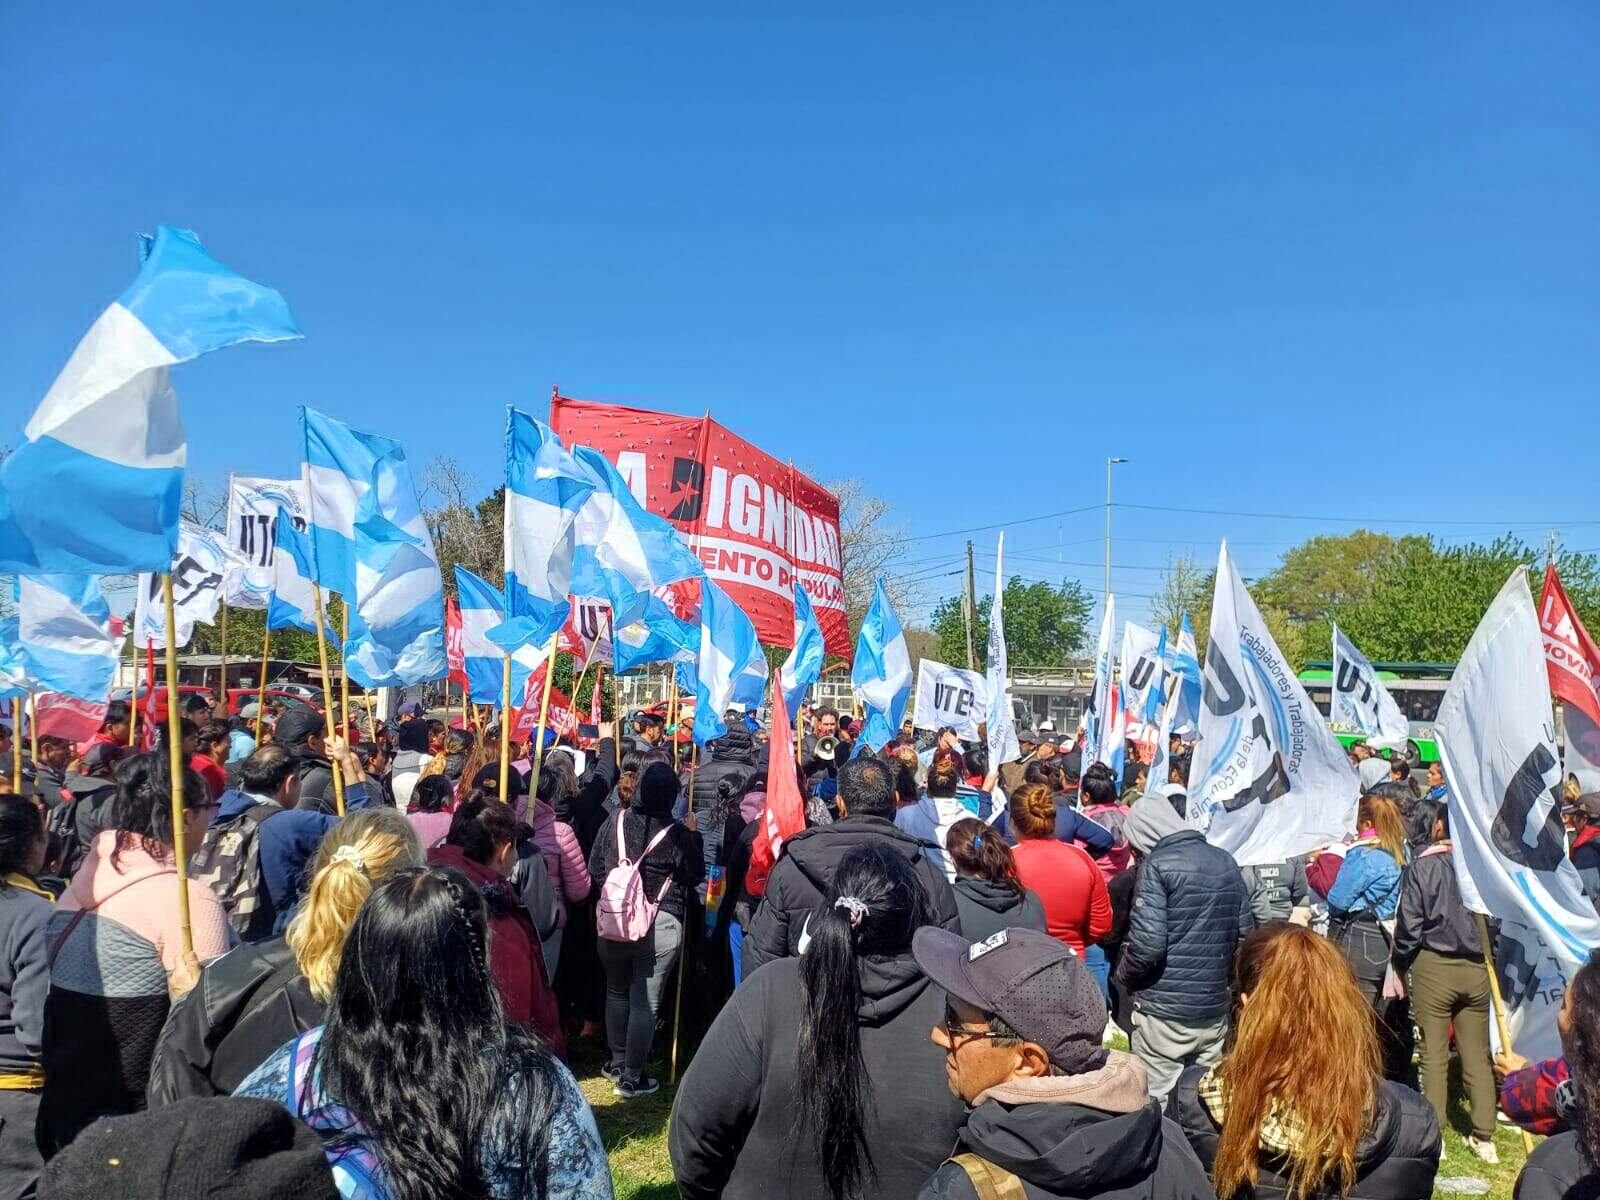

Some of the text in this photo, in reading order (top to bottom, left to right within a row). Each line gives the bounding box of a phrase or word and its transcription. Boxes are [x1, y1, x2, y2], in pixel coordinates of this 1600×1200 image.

[614, 451, 841, 573] A DIGNIDAD
[1240, 625, 1309, 774] Trabajadores y Trabajadoras
